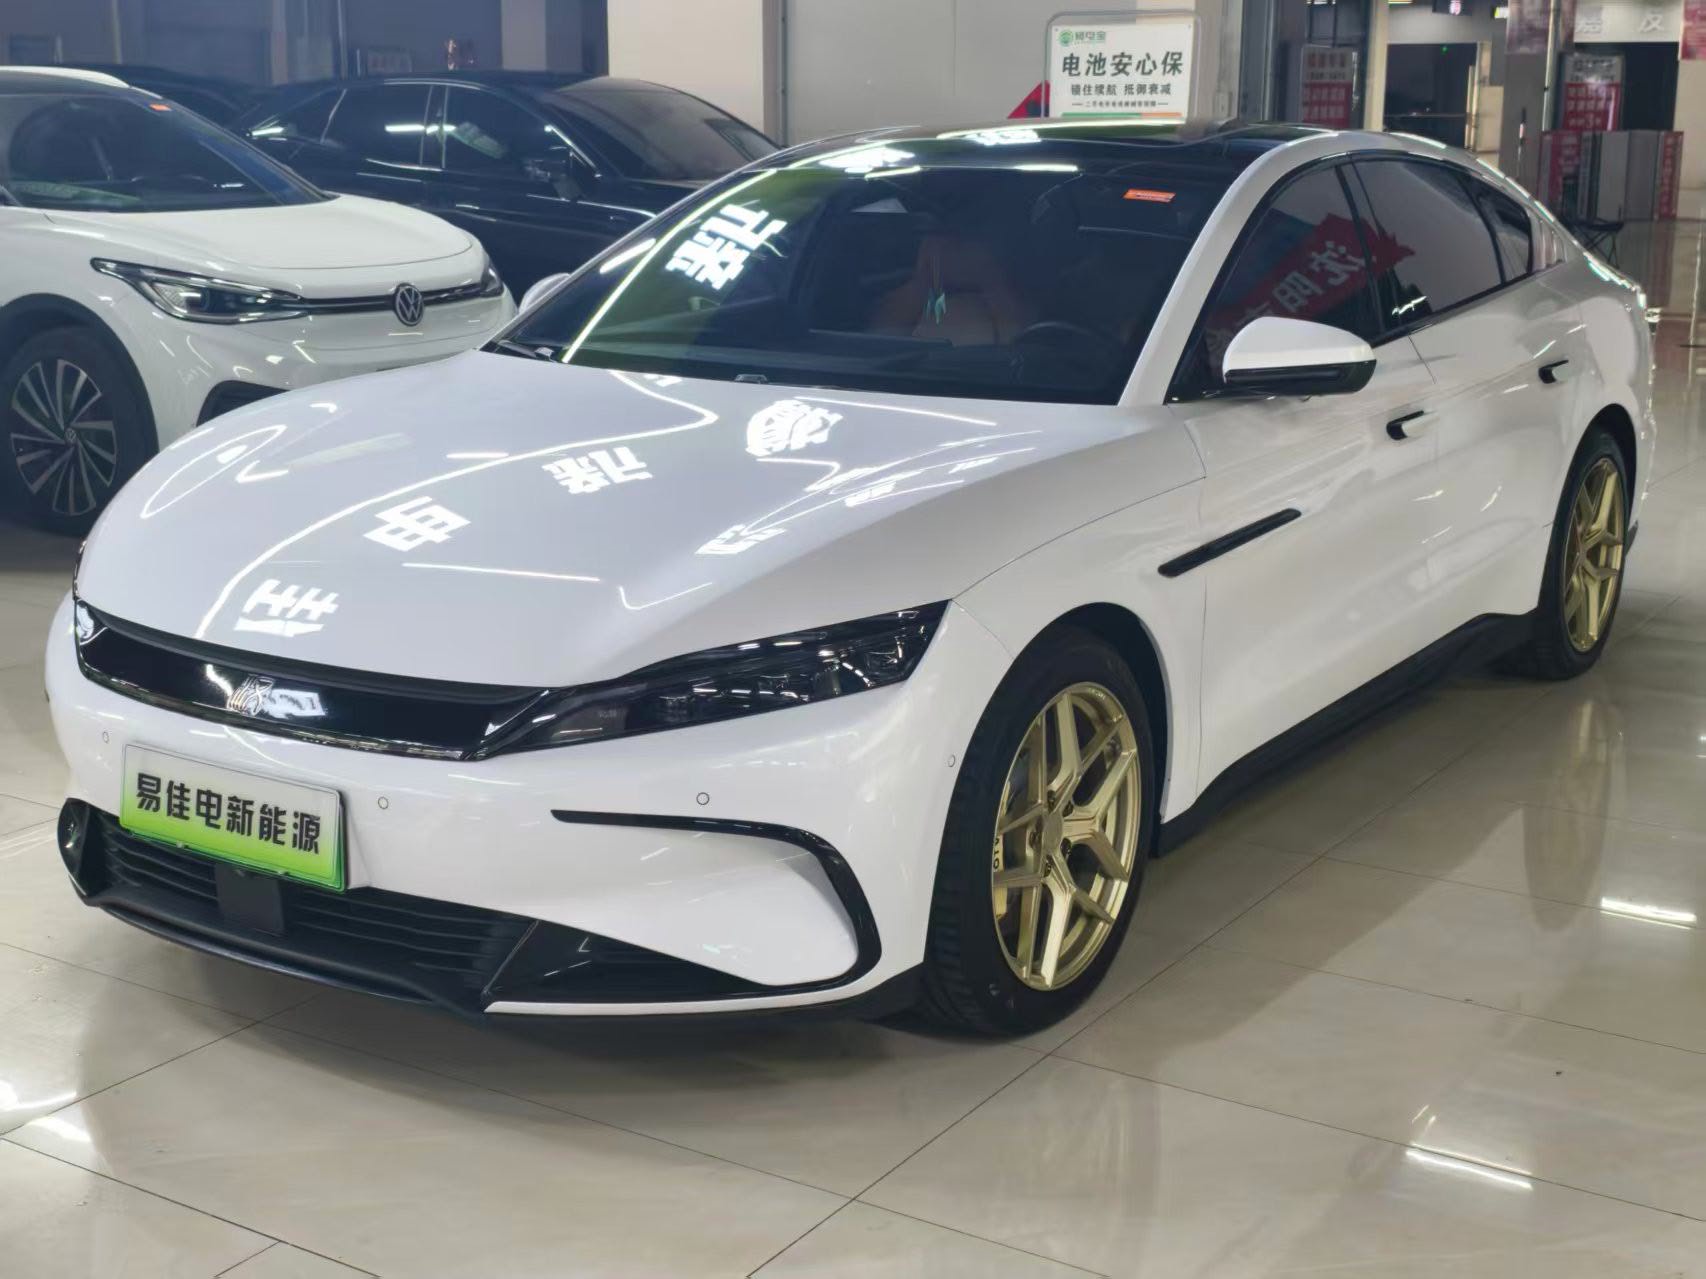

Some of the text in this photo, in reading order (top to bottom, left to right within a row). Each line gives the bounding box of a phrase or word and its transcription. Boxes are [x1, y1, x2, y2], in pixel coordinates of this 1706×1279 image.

[1062, 51, 1183, 77] 电池安心保
[136, 772, 321, 854] 易佳电新能源
